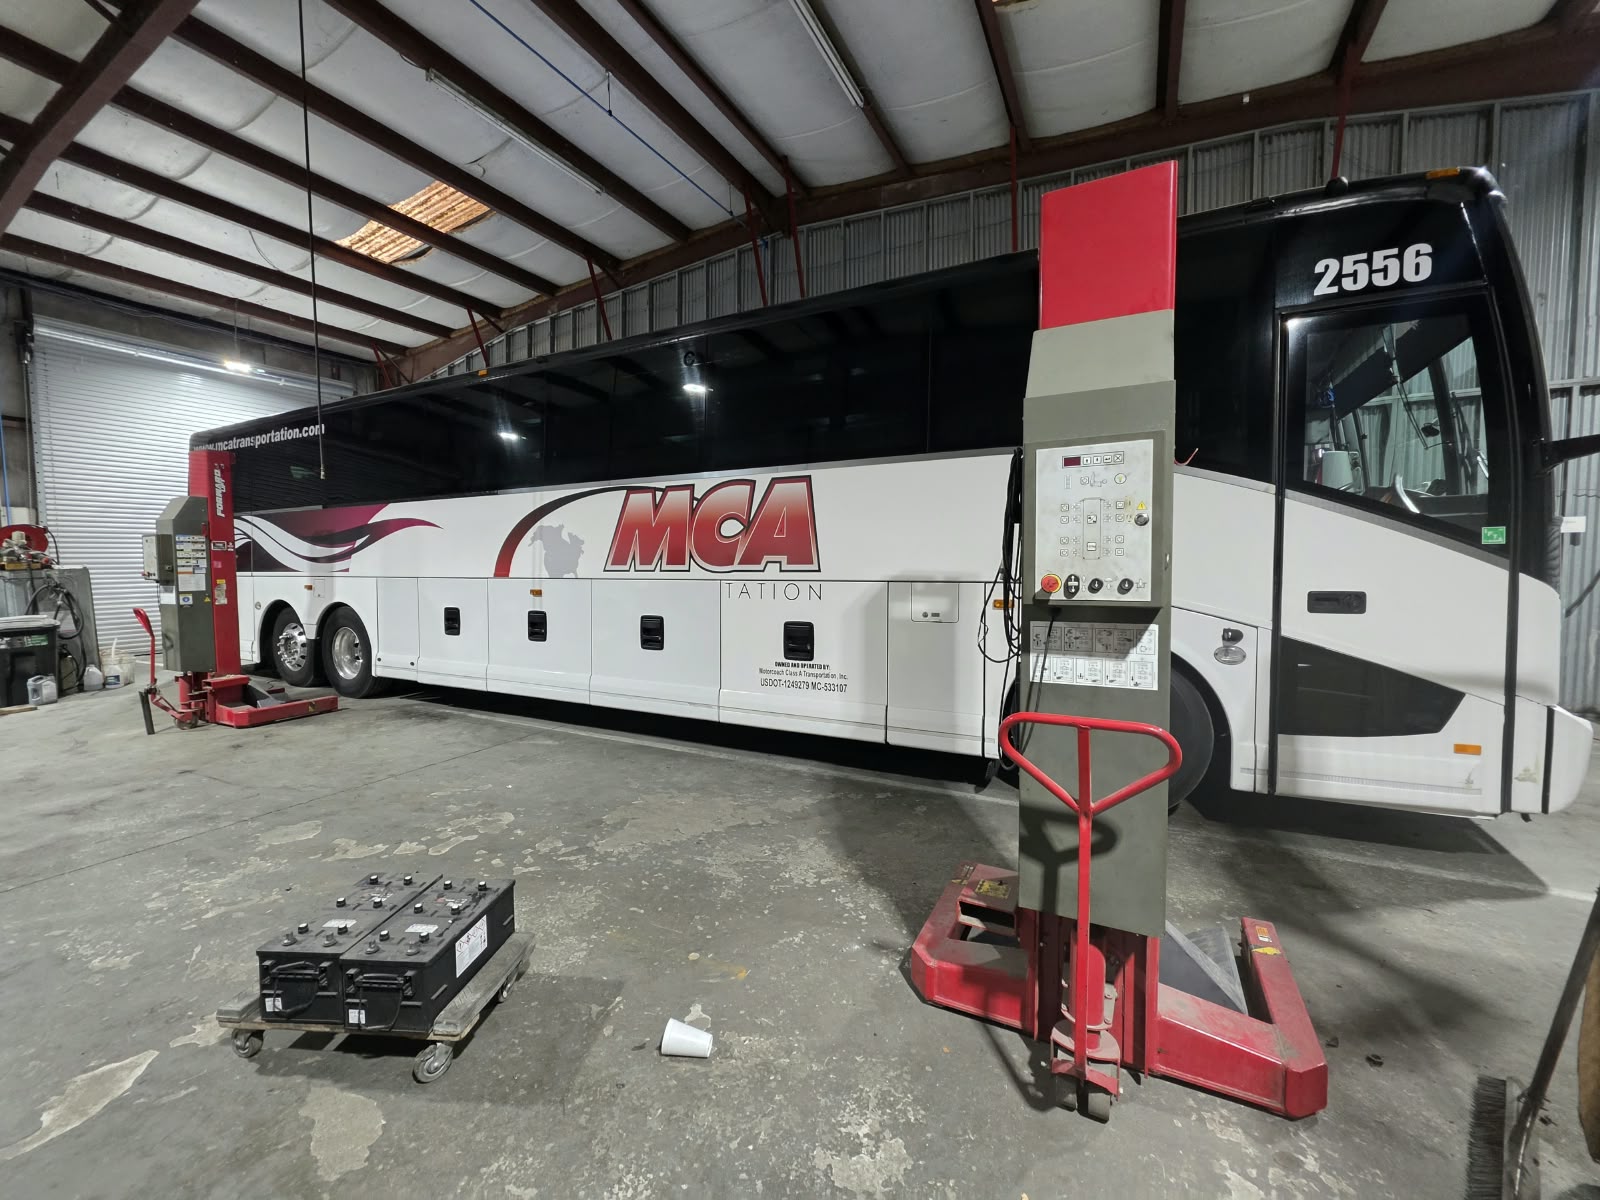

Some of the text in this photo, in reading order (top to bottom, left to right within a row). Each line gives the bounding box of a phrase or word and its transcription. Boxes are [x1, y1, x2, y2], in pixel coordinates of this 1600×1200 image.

[1313, 242, 1433, 296] 2556
[603, 474, 821, 574] MCA
[725, 582, 822, 601] TATION
[759, 667, 785, 676] Motorcoach
[785, 669, 798, 677] Class
[838, 672, 849, 680] Inc.
[800, 662, 822, 670] OPERATED
[760, 677, 848, 693] USDOT-1249279 MC-533107
